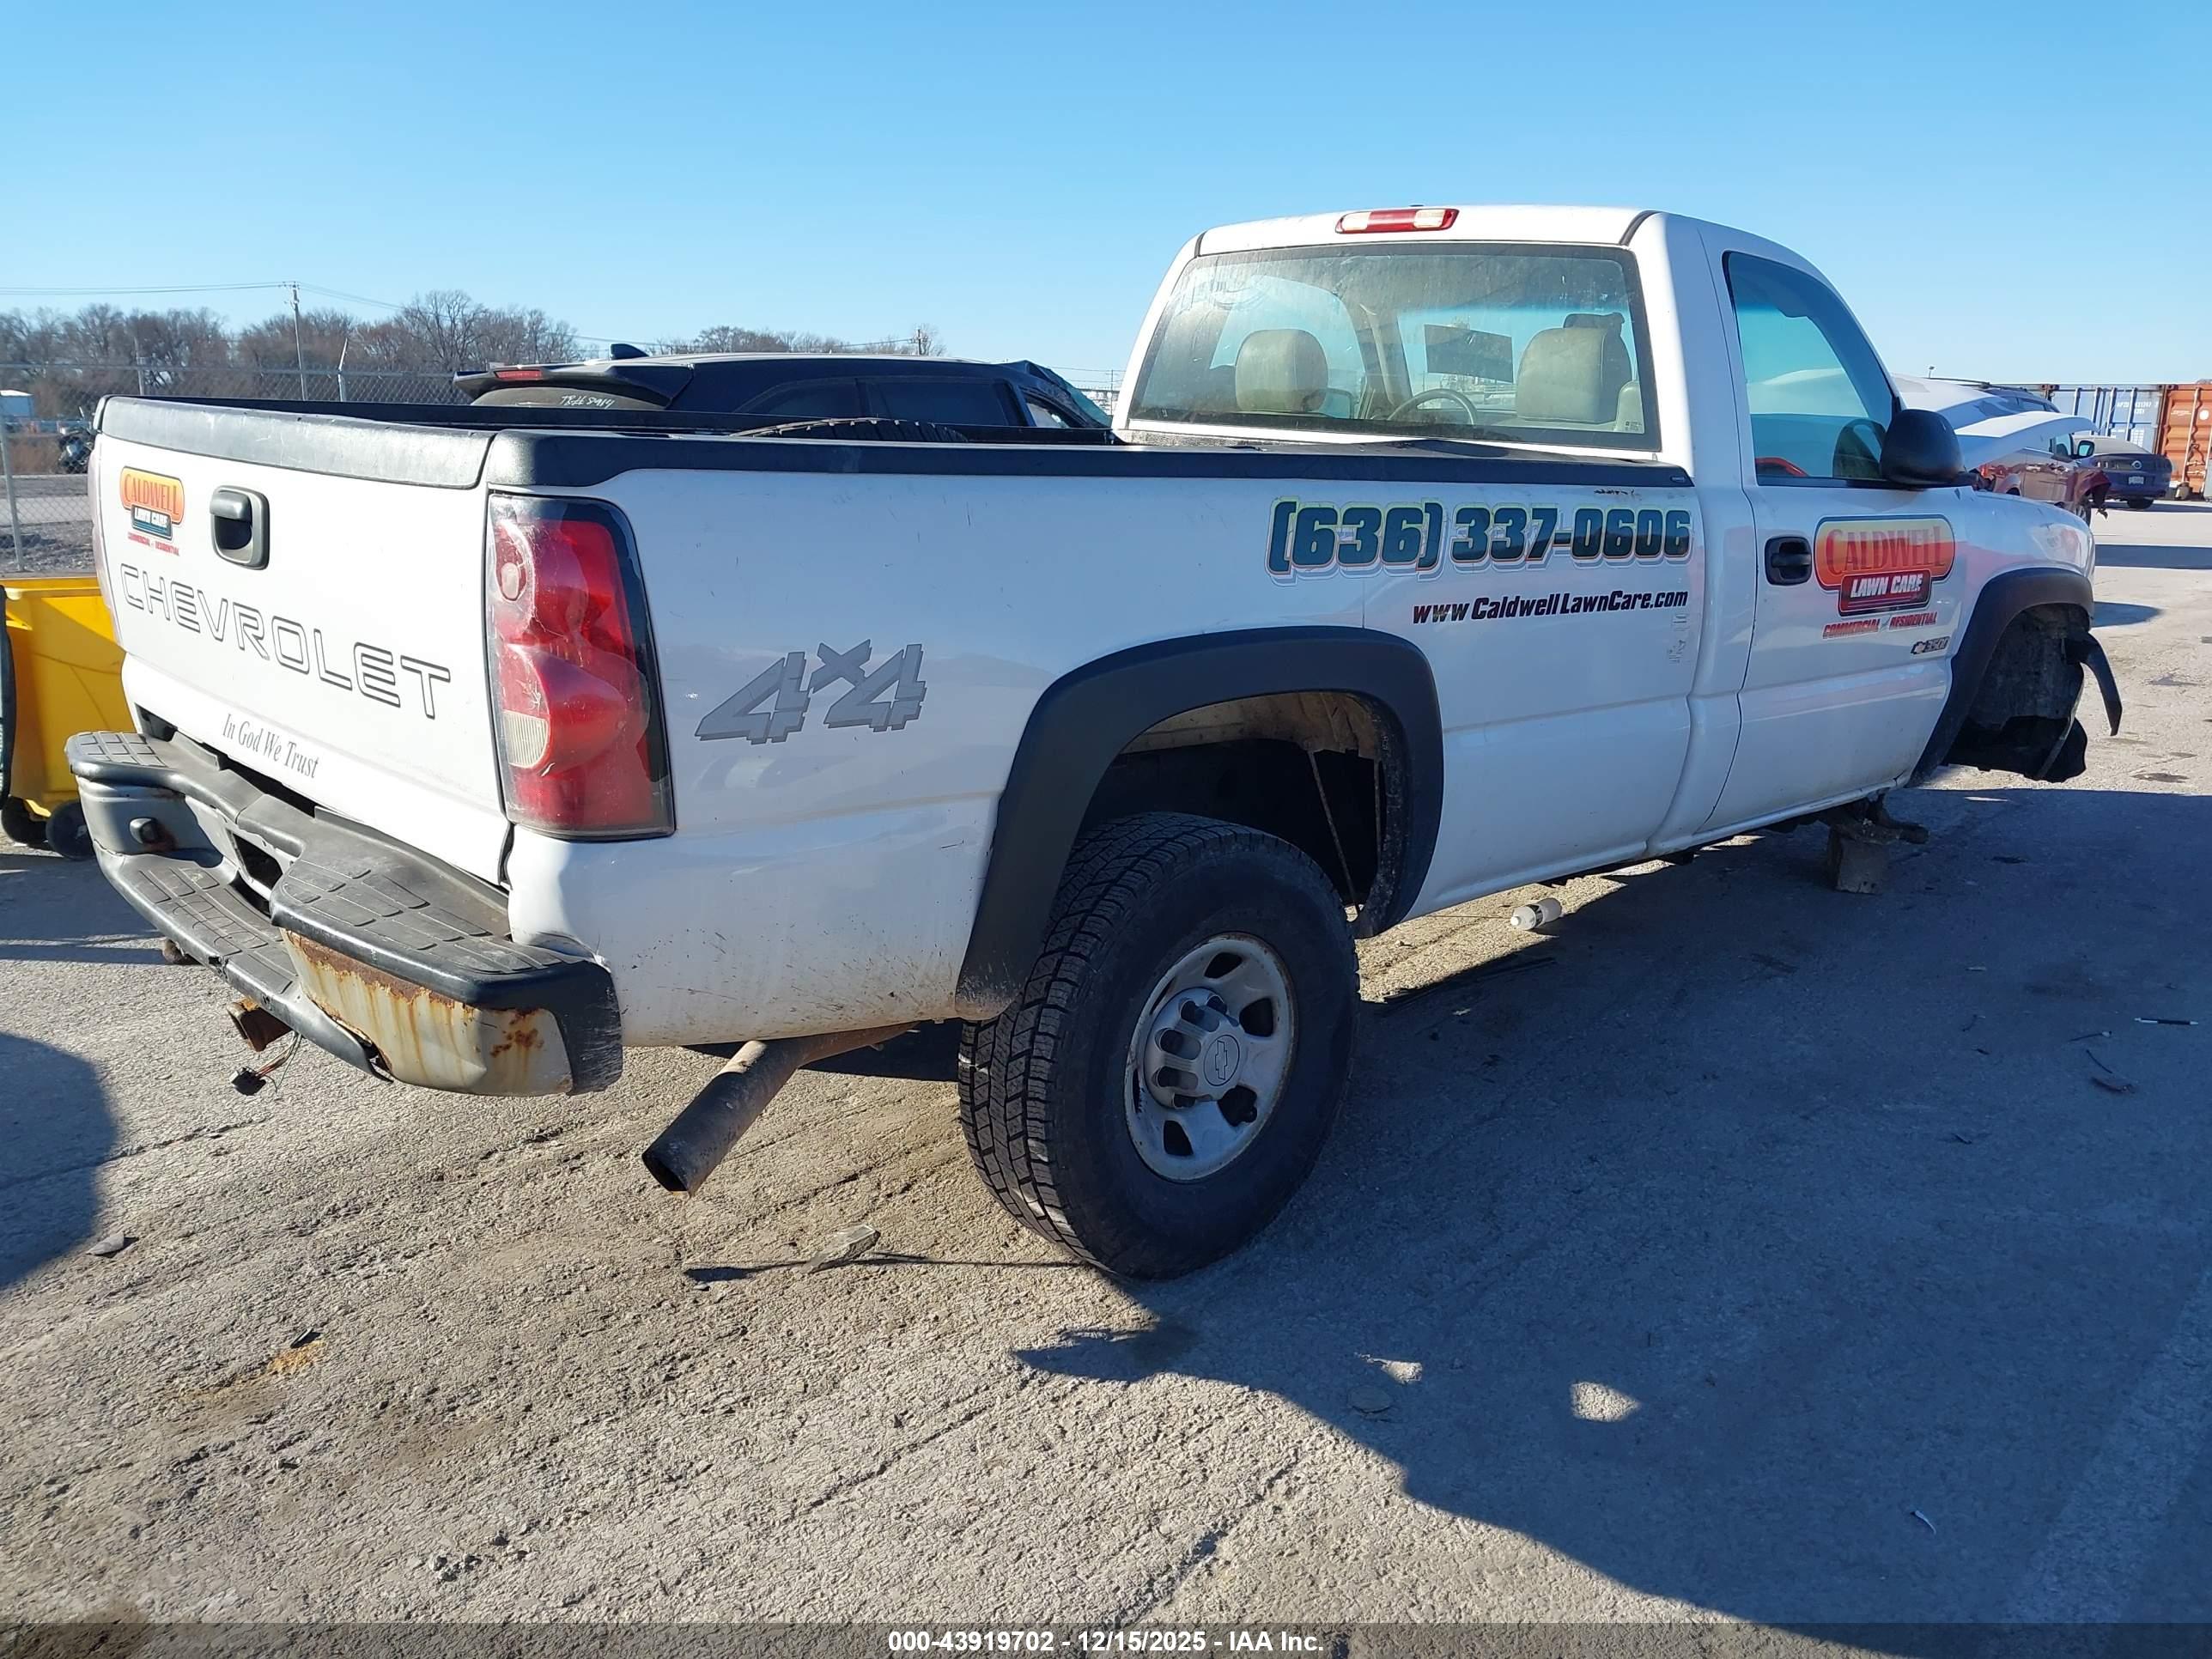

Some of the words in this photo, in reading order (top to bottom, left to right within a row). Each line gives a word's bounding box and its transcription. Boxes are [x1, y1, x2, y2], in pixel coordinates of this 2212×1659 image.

[125, 473, 179, 515] CALDWELL
[1267, 498, 1443, 575] (636)
[1450, 507, 1694, 563] 337-0606
[1826, 526, 1945, 575] CALDWELL
[1850, 577, 1889, 599] LAWN
[1890, 574, 1924, 594] CARE
[120, 562, 451, 720] CHEVROLET
[1889, 611, 1938, 629] RESIDENTIAL
[222, 713, 236, 739] In
[238, 720, 264, 752] God
[263, 731, 283, 762] We
[284, 740, 319, 779] Trust
